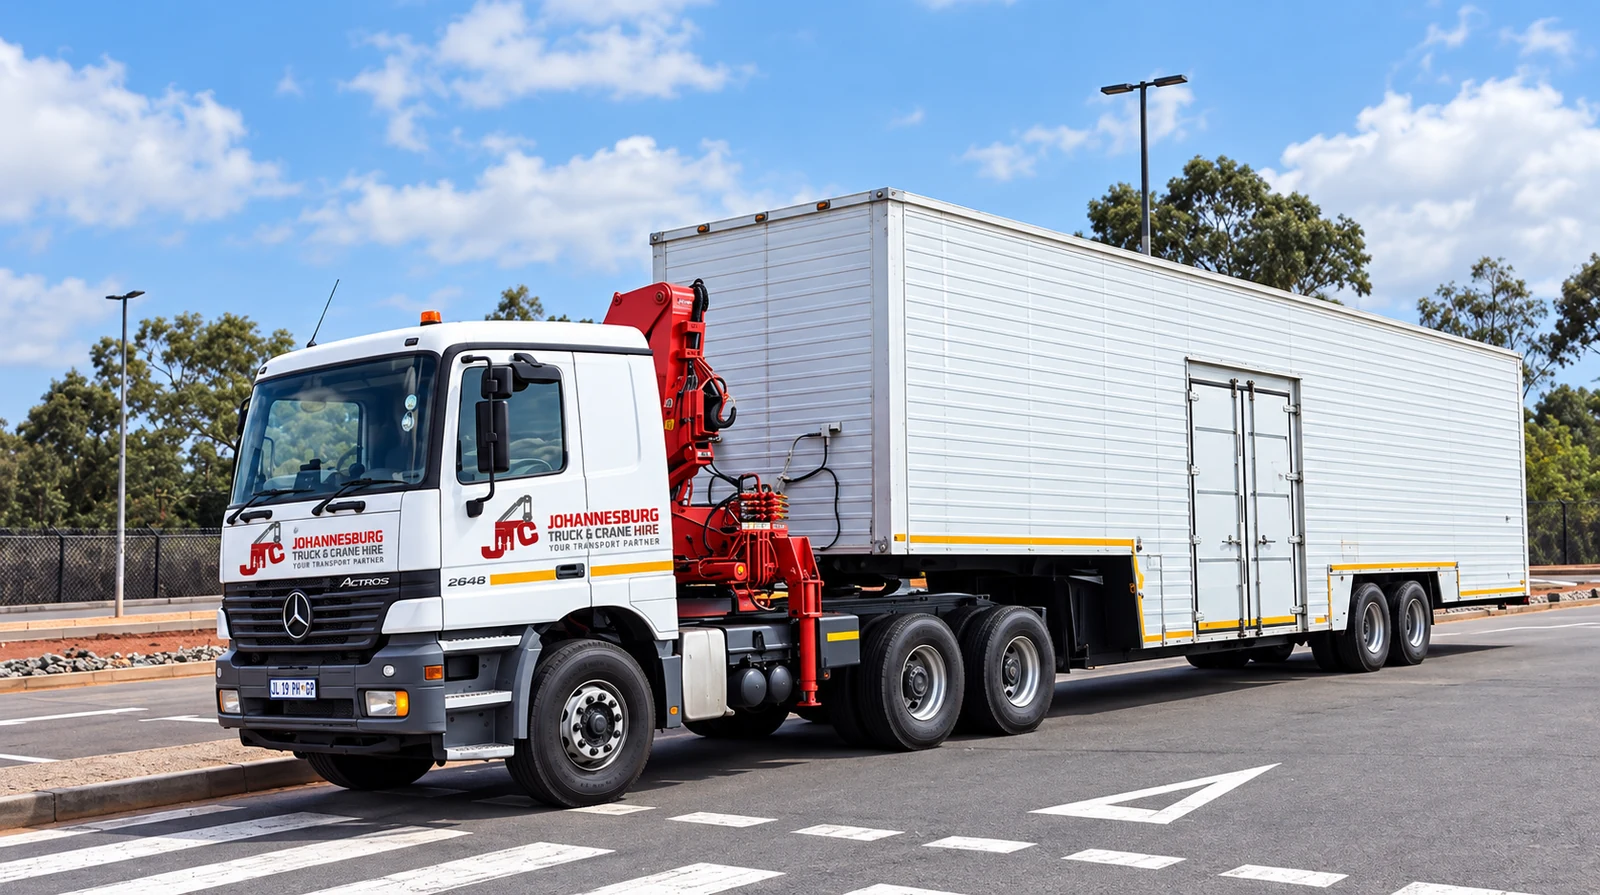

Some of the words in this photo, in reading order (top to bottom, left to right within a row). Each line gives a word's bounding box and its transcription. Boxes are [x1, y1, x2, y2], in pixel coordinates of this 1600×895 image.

[548, 508, 659, 529] JOHANNESBURG
[292, 530, 383, 550] JOHANNESBURG
[548, 528, 584, 542] TRUCK
[586, 527, 593, 539] &
[595, 526, 631, 539] CRANE
[634, 524, 659, 536] HIRE
[549, 543, 571, 551] YOUR
[573, 540, 620, 550] TRANSPORT
[623, 538, 660, 547] PARTNER
[292, 549, 321, 561] TRUCK
[322, 549, 329, 558] &
[330, 547, 360, 558] CRANE
[361, 545, 383, 555] HIRE
[312, 559, 350, 568] TRANSPORT
[353, 556, 384, 565] PARTNER
[447, 576, 486, 587] 2648
[271, 682, 279, 695] JL
[282, 682, 289, 695] 19
[292, 682, 300, 695] PH
[306, 682, 314, 695] GP
